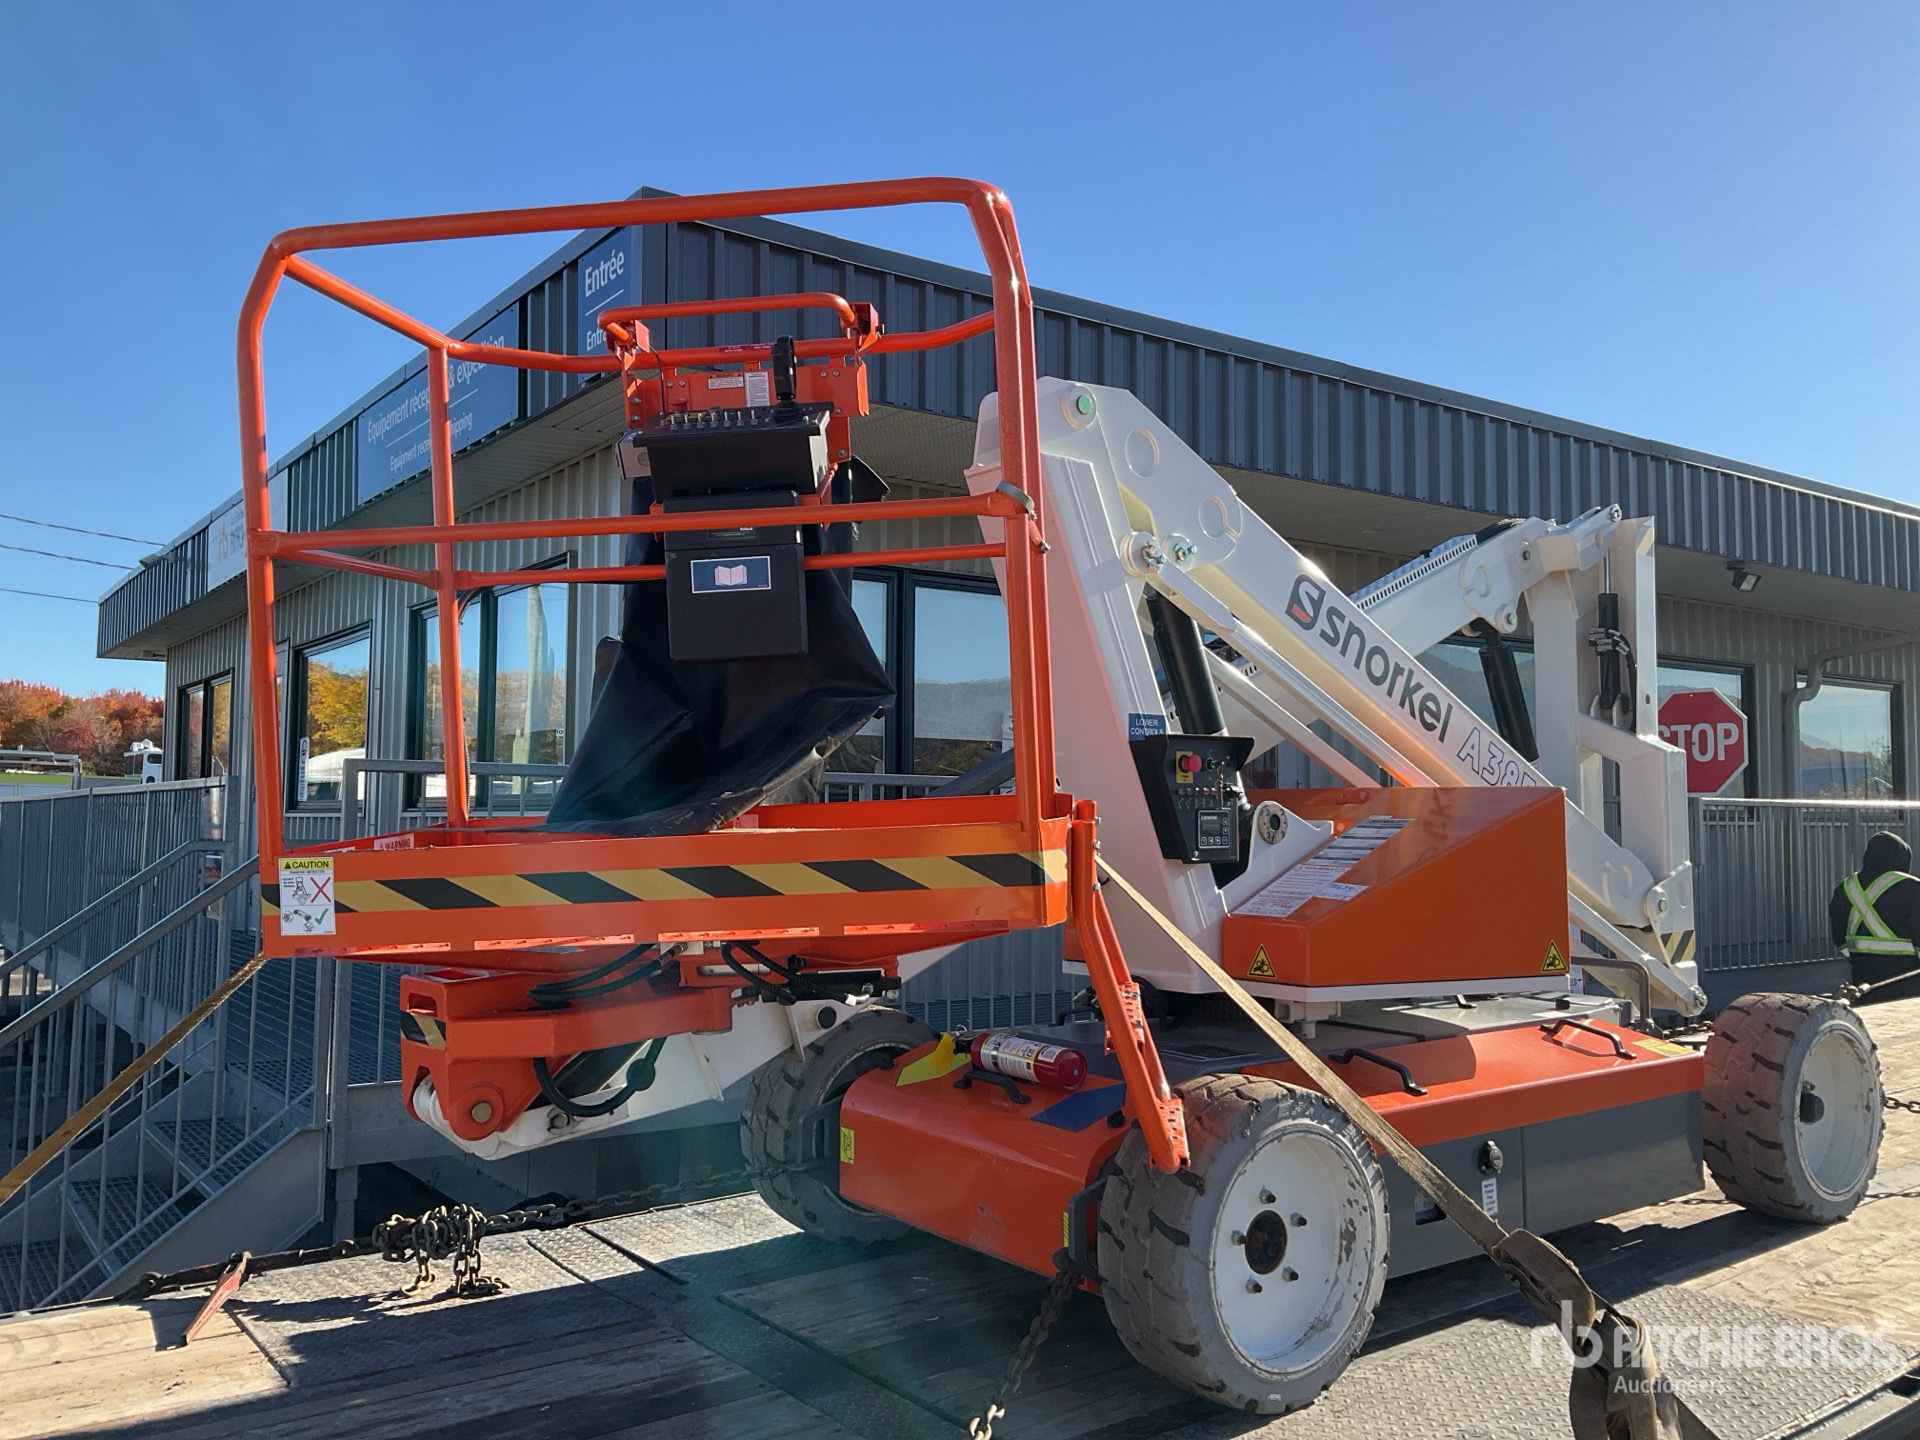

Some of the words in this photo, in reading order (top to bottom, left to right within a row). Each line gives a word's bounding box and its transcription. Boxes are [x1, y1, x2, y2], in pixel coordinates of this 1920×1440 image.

[585, 249, 625, 298] Entrée
[586, 328, 607, 352] Entra
[367, 397, 410, 445] Équipement
[448, 364, 455, 390] &
[390, 443, 417, 472] Equipment
[1318, 605, 1454, 744] snorkel
[1130, 727, 1164, 736] CONTROLS
[1135, 718, 1159, 727] LOWER
[384, 838, 411, 850] WARNING
[292, 860, 330, 869] CAUTION
